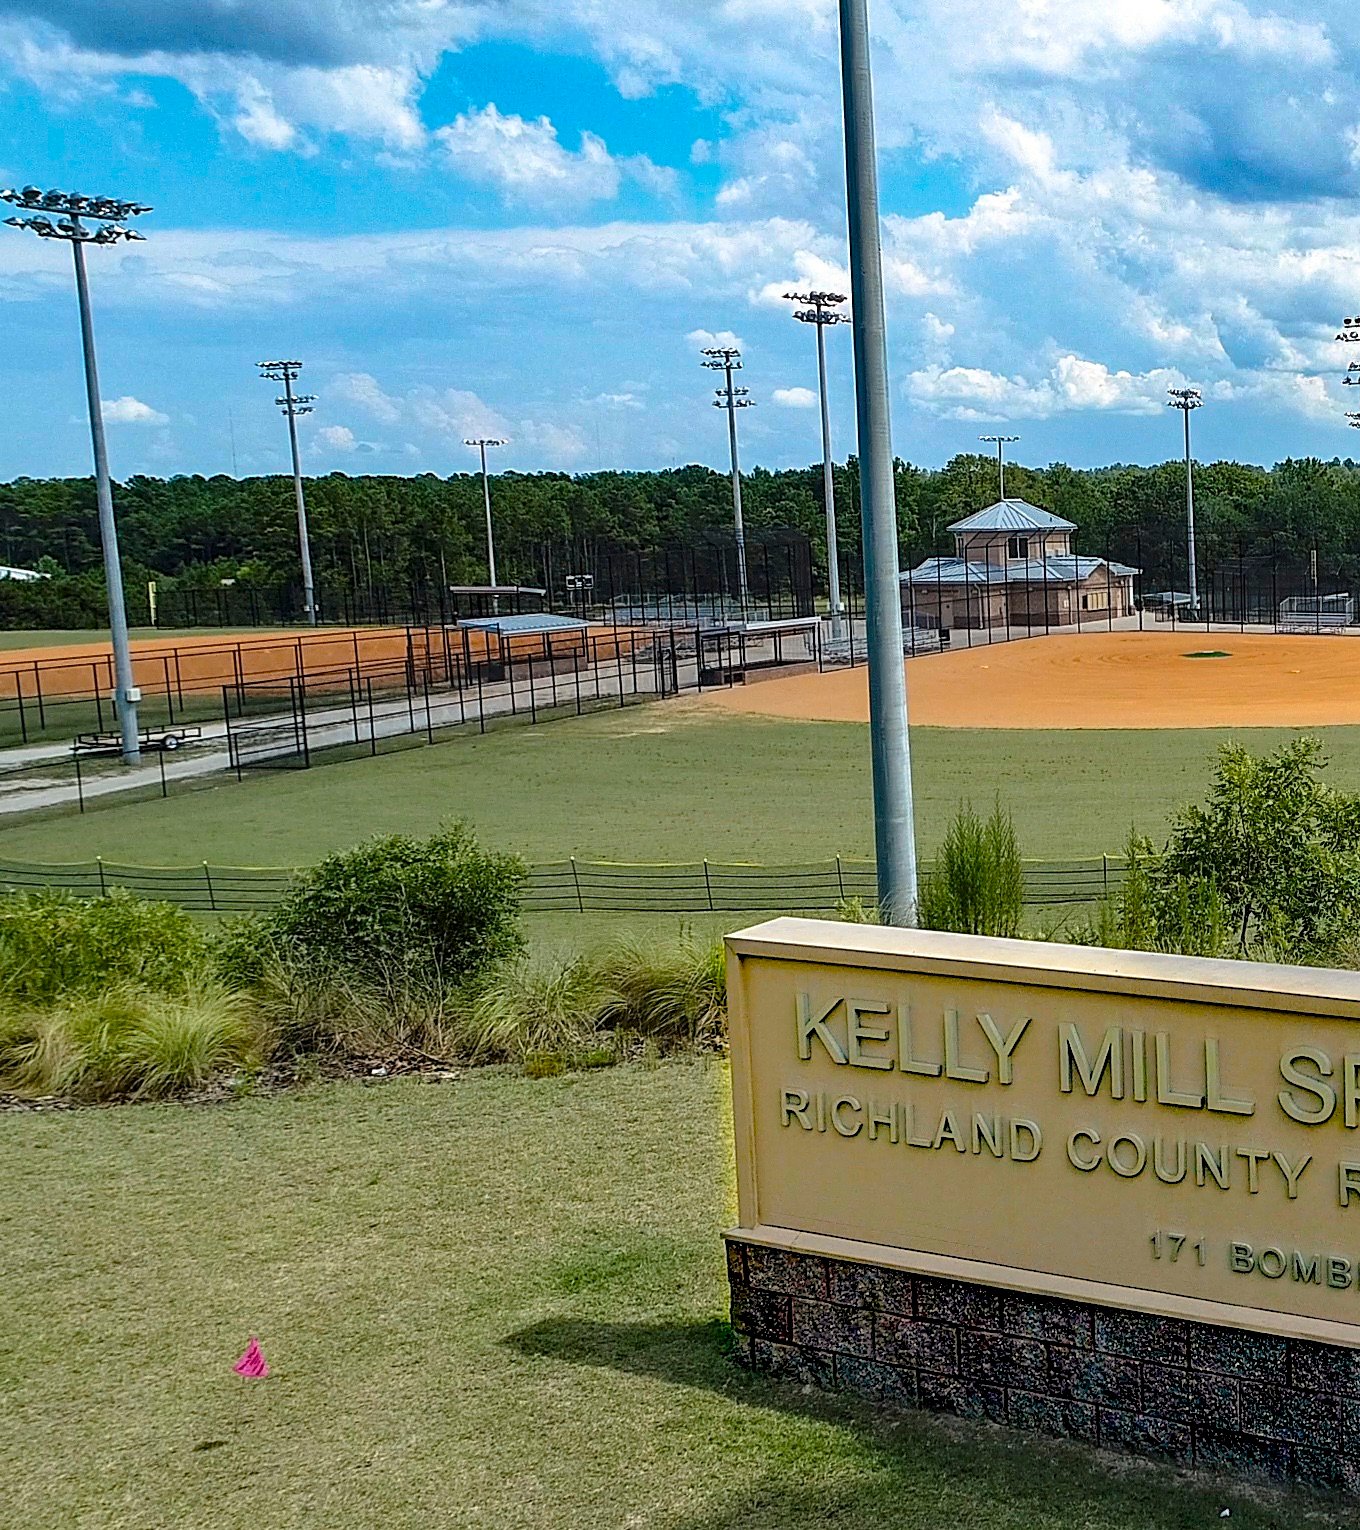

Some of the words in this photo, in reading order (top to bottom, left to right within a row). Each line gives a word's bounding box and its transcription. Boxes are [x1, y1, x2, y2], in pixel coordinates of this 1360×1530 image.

[795, 992, 1032, 1086] KELLY
[1058, 1021, 1255, 1116] MILL
[780, 1087, 1043, 1162] RICHLAND
[1066, 1127, 1312, 1199] COUNTY
[1149, 1229, 1207, 1266] 171
